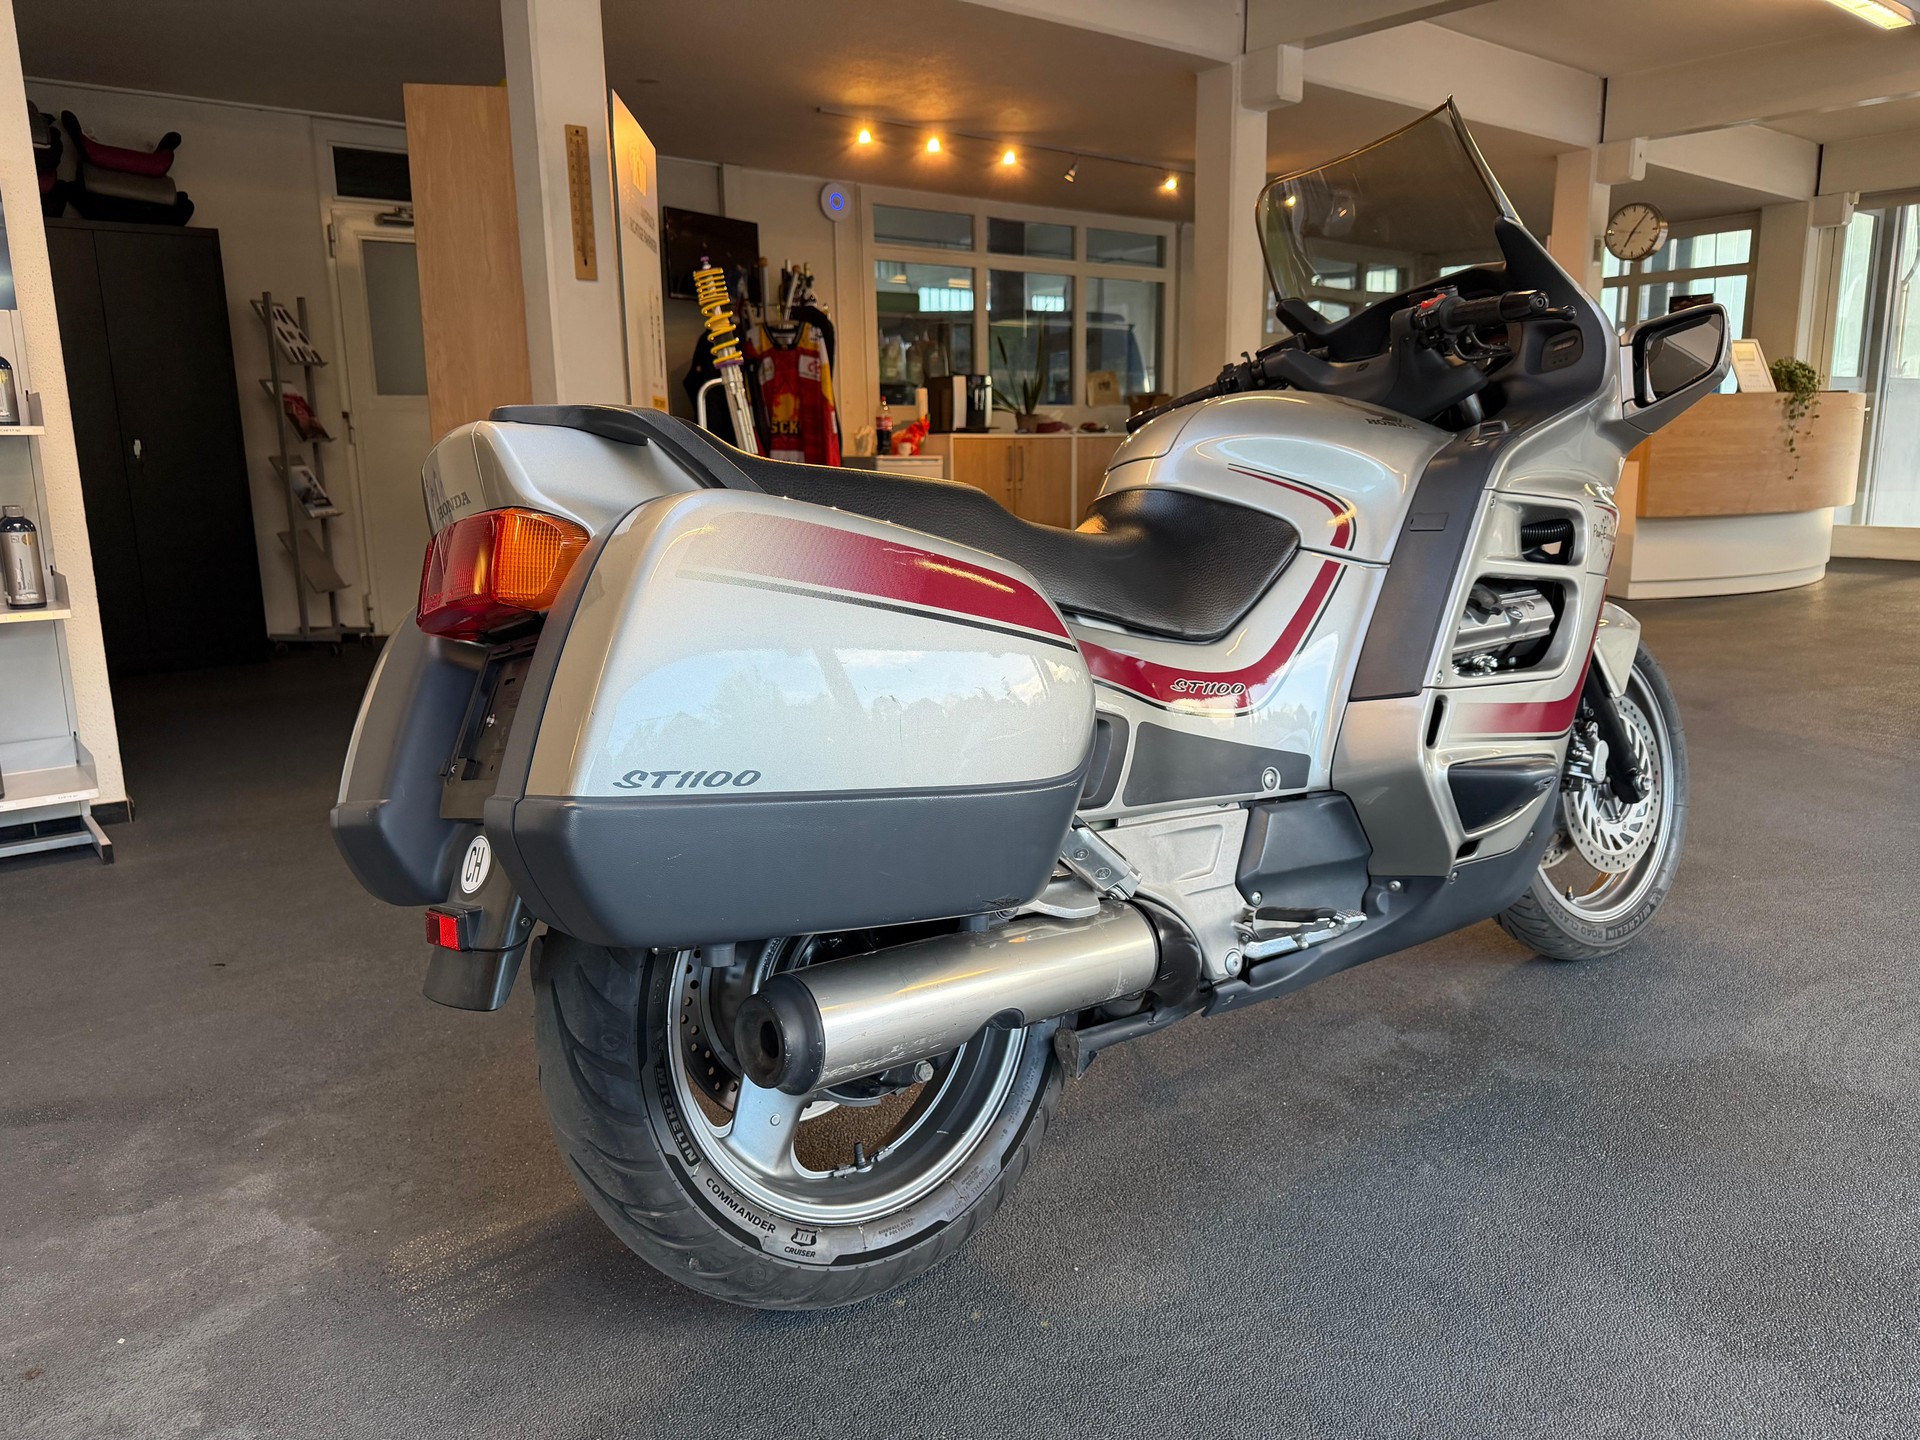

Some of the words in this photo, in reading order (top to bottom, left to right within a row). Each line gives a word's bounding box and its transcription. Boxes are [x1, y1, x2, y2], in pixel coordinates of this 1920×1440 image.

[437, 491, 472, 520] HONDA
[1169, 677, 1246, 696] ST1100
[612, 769, 762, 789] ST1100
[465, 845, 485, 883] CH
[1580, 926, 1604, 939] ROAD
[1607, 904, 1652, 939] MICHELIN
[657, 1067, 698, 1163] MICHELIN
[705, 1177, 777, 1235] COMMANDER
[784, 1246, 816, 1258] CRUISER
